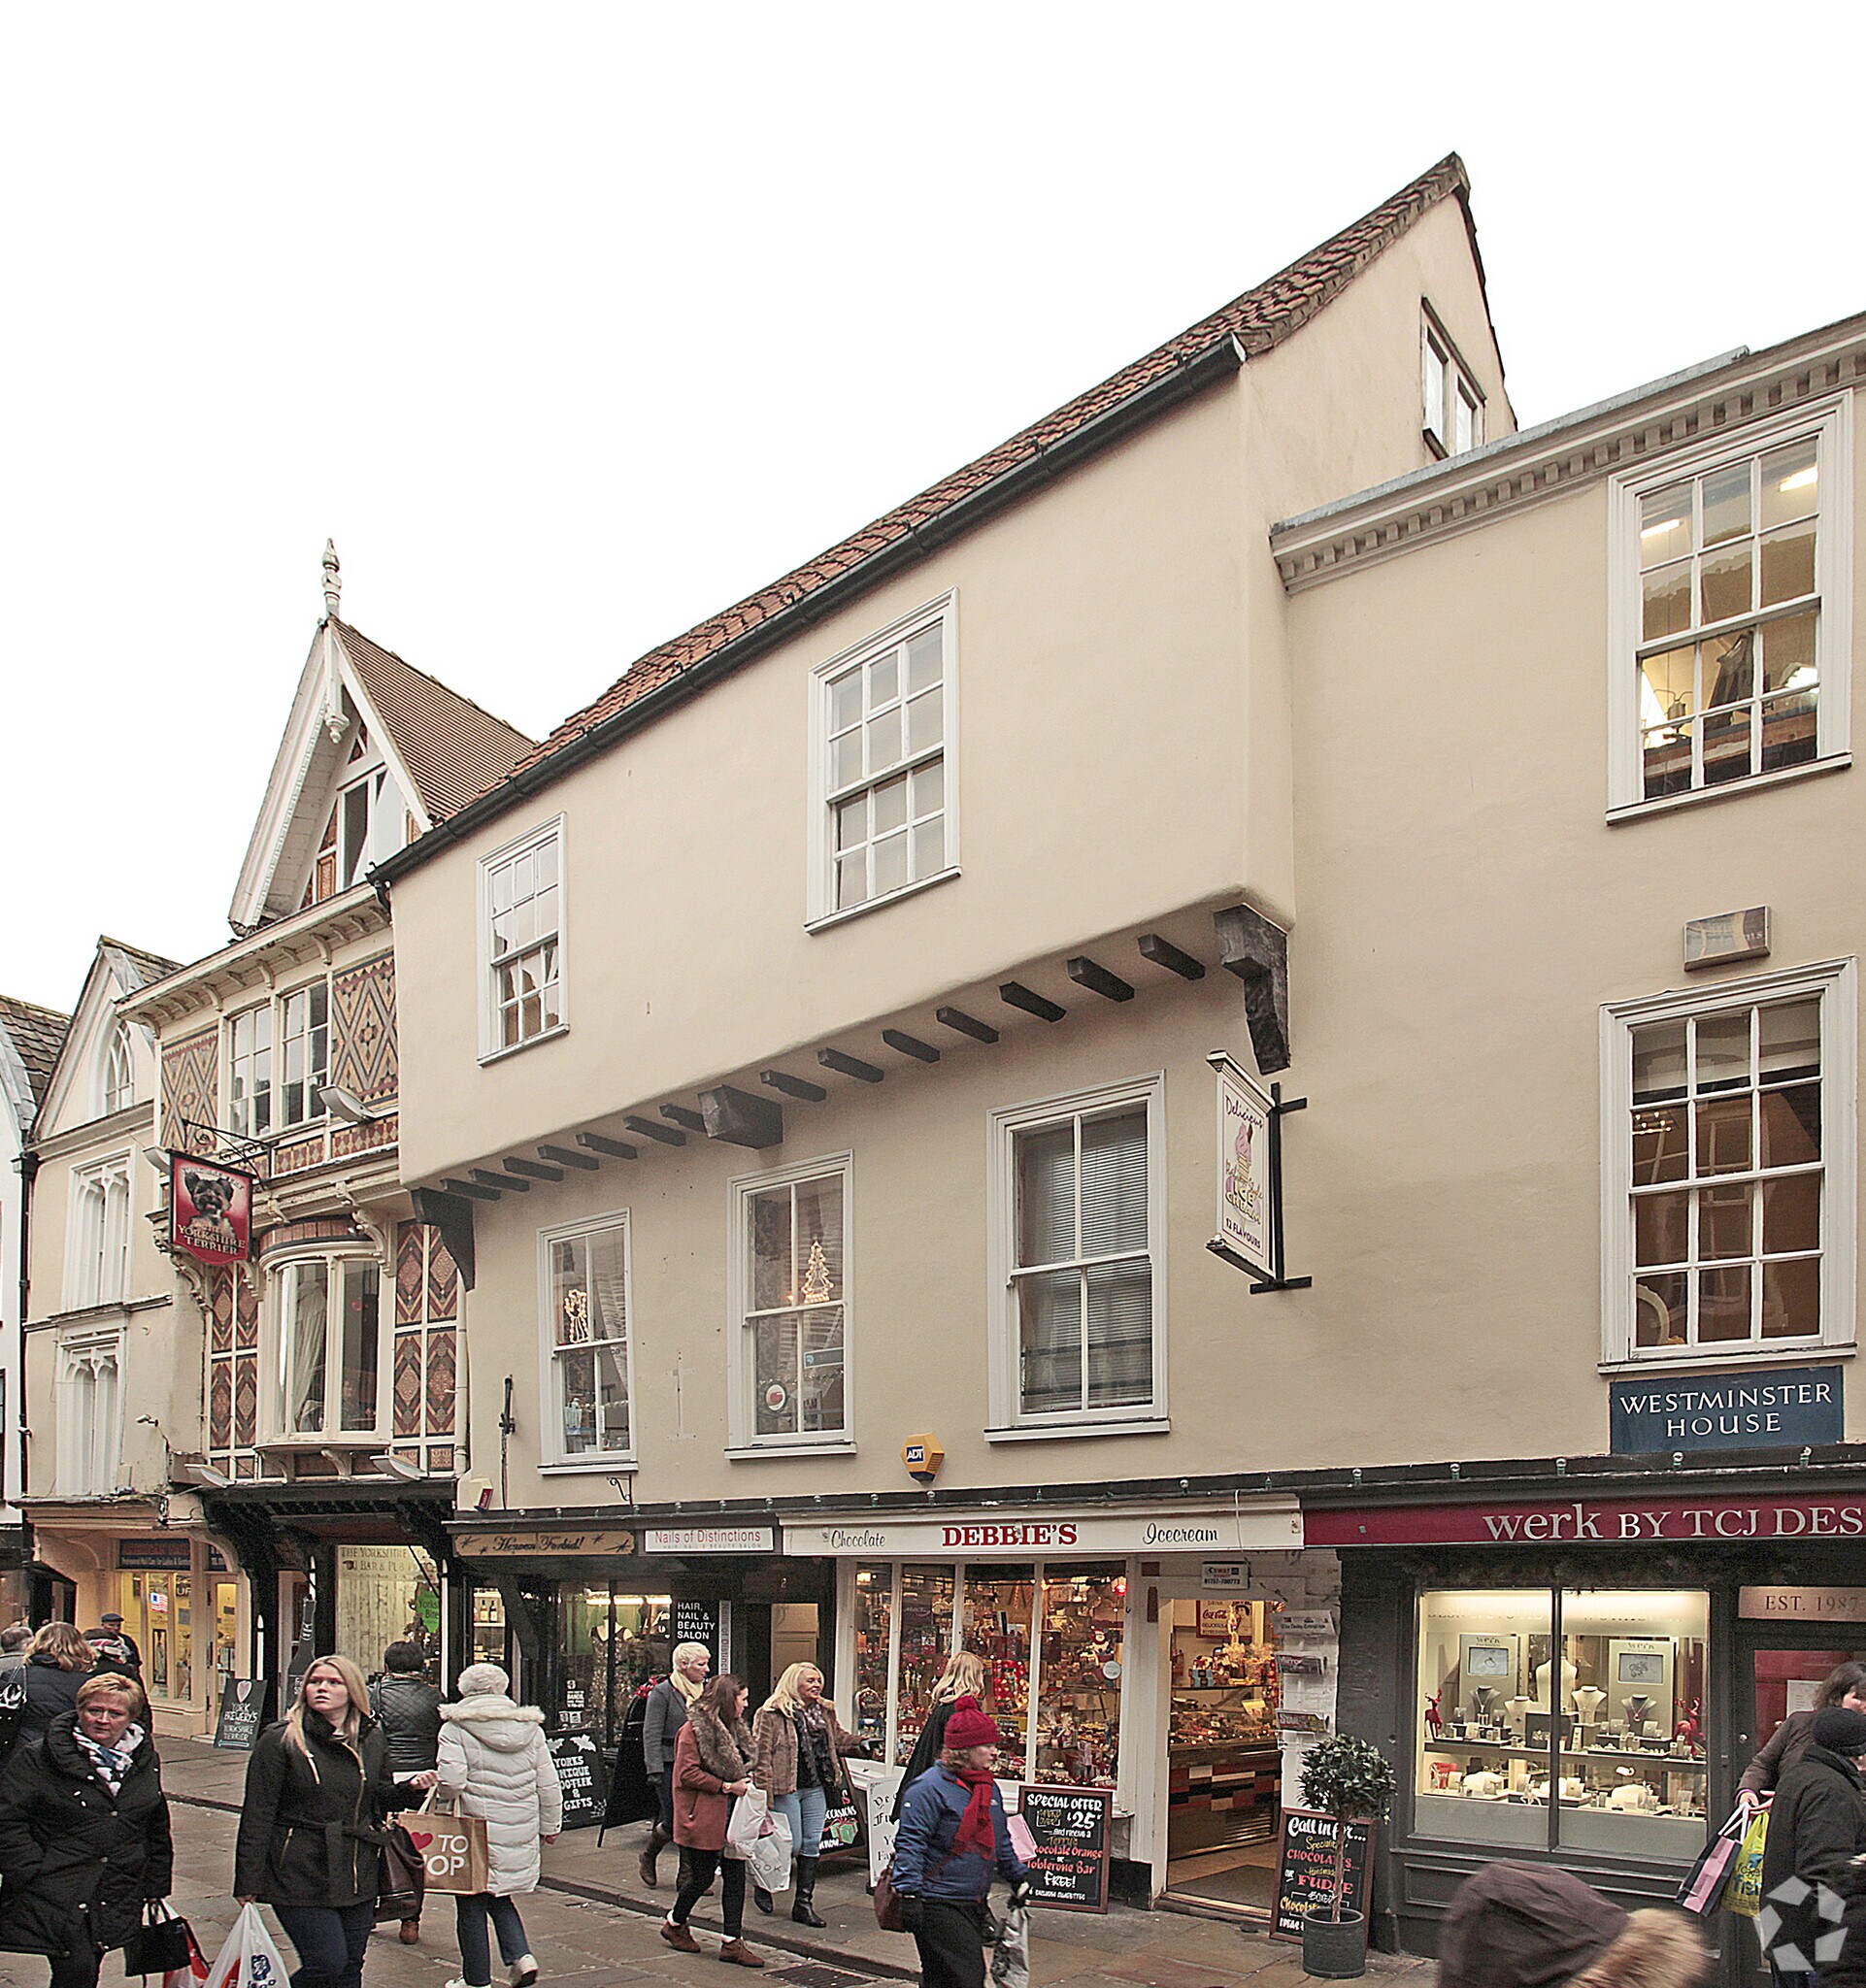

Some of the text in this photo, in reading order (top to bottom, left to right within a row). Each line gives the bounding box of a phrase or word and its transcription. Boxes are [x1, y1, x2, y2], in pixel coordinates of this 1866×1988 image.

[1233, 1179, 1253, 1208] ICE
[1225, 1190, 1261, 1225] CREAM
[178, 1224, 246, 1248] YORKSHIRE
[1233, 1223, 1261, 1249] FLAVOURS
[184, 1236, 239, 1255] TERRIER
[1619, 1382, 1833, 1415] WESTMINSTER
[1666, 1412, 1782, 1438] HOUSE
[906, 1448, 924, 1459] ADT
[1482, 1503, 1864, 1541] werk BY TCJ DES
[654, 1529, 761, 1543] Nails of Distinctions
[831, 1530, 885, 1549] Chocolate
[942, 1523, 1079, 1547] DEBBIE'S
[1143, 1522, 1218, 1545] Icecream
[341, 1547, 358, 1557] THE
[781, 1577, 787, 1589] 2
[677, 1602, 703, 1612] HAIR,
[1765, 1595, 1858, 1612] EST. 1987
[677, 1611, 710, 1621] NAIL &
[677, 1621, 716, 1631] BEAUTY
[677, 1631, 710, 1640] SALON
[554, 1755, 584, 1768] YORKS
[559, 1766, 590, 1779] NIQUE
[572, 1788, 581, 1798] &
[563, 1798, 593, 1810] GIFTS
[1027, 1793, 1103, 1811] SPECIAL OFFER
[1287, 1816, 1366, 1841] Call in fr...
[437, 1834, 469, 1854] TO
[1036, 1845, 1103, 1860] ocolate Orange
[1076, 1860, 1096, 1874] Bar
[1044, 1870, 1076, 1888] FREE!
